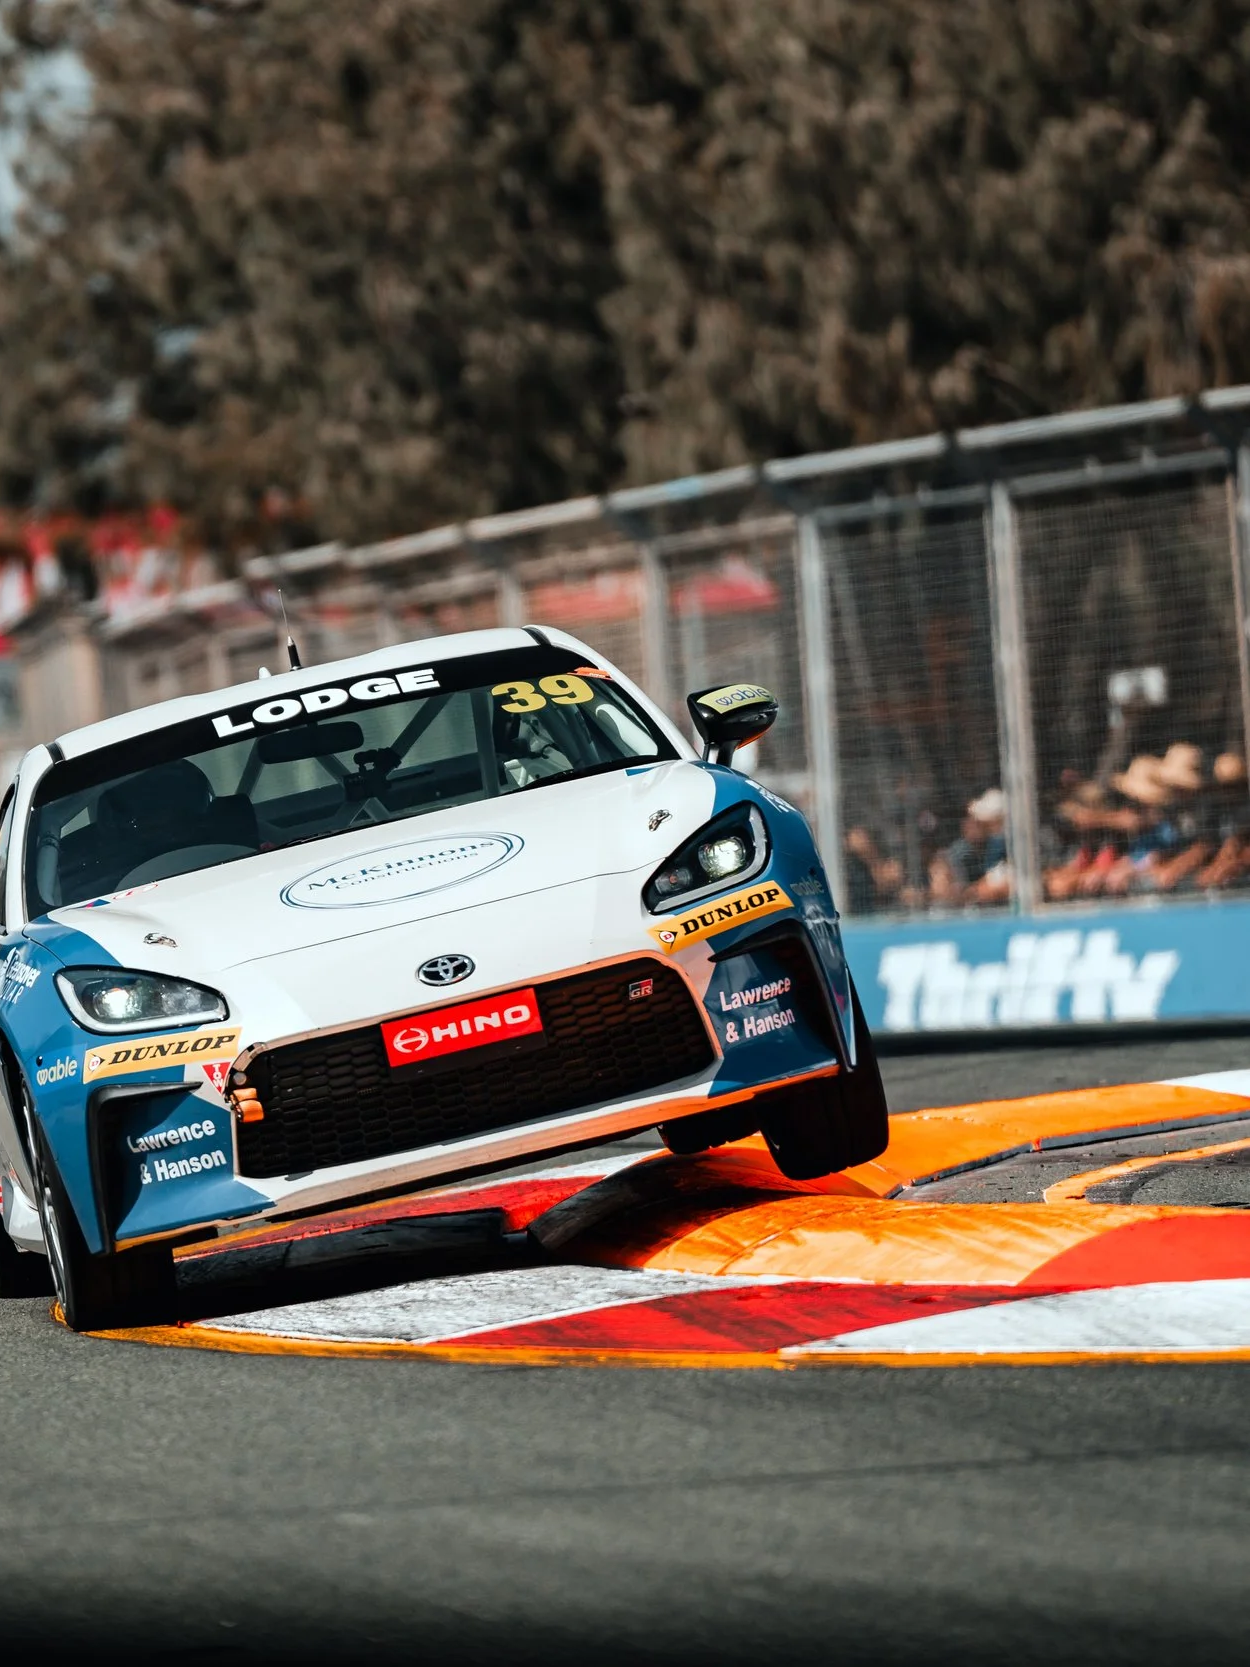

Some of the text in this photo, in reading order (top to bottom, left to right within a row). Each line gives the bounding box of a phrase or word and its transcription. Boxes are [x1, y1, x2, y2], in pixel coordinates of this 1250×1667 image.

[211, 668, 441, 738] LODGE
[490, 674, 595, 713] 39
[715, 686, 771, 706] wable
[335, 852, 479, 890] Constructions
[680, 888, 780, 935] DUNLOP
[630, 985, 652, 998] GR
[719, 977, 792, 1012] Lawrence
[878, 929, 1180, 1031] Thrifty
[431, 1004, 531, 1042] HINO
[725, 1008, 796, 1042] & Hanson
[108, 1034, 236, 1065] DUNLOP
[36, 1056, 78, 1087] wable
[212, 1063, 224, 1087] TOW
[126, 1119, 216, 1153] Lawrence
[140, 1149, 227, 1185] & Hanson
